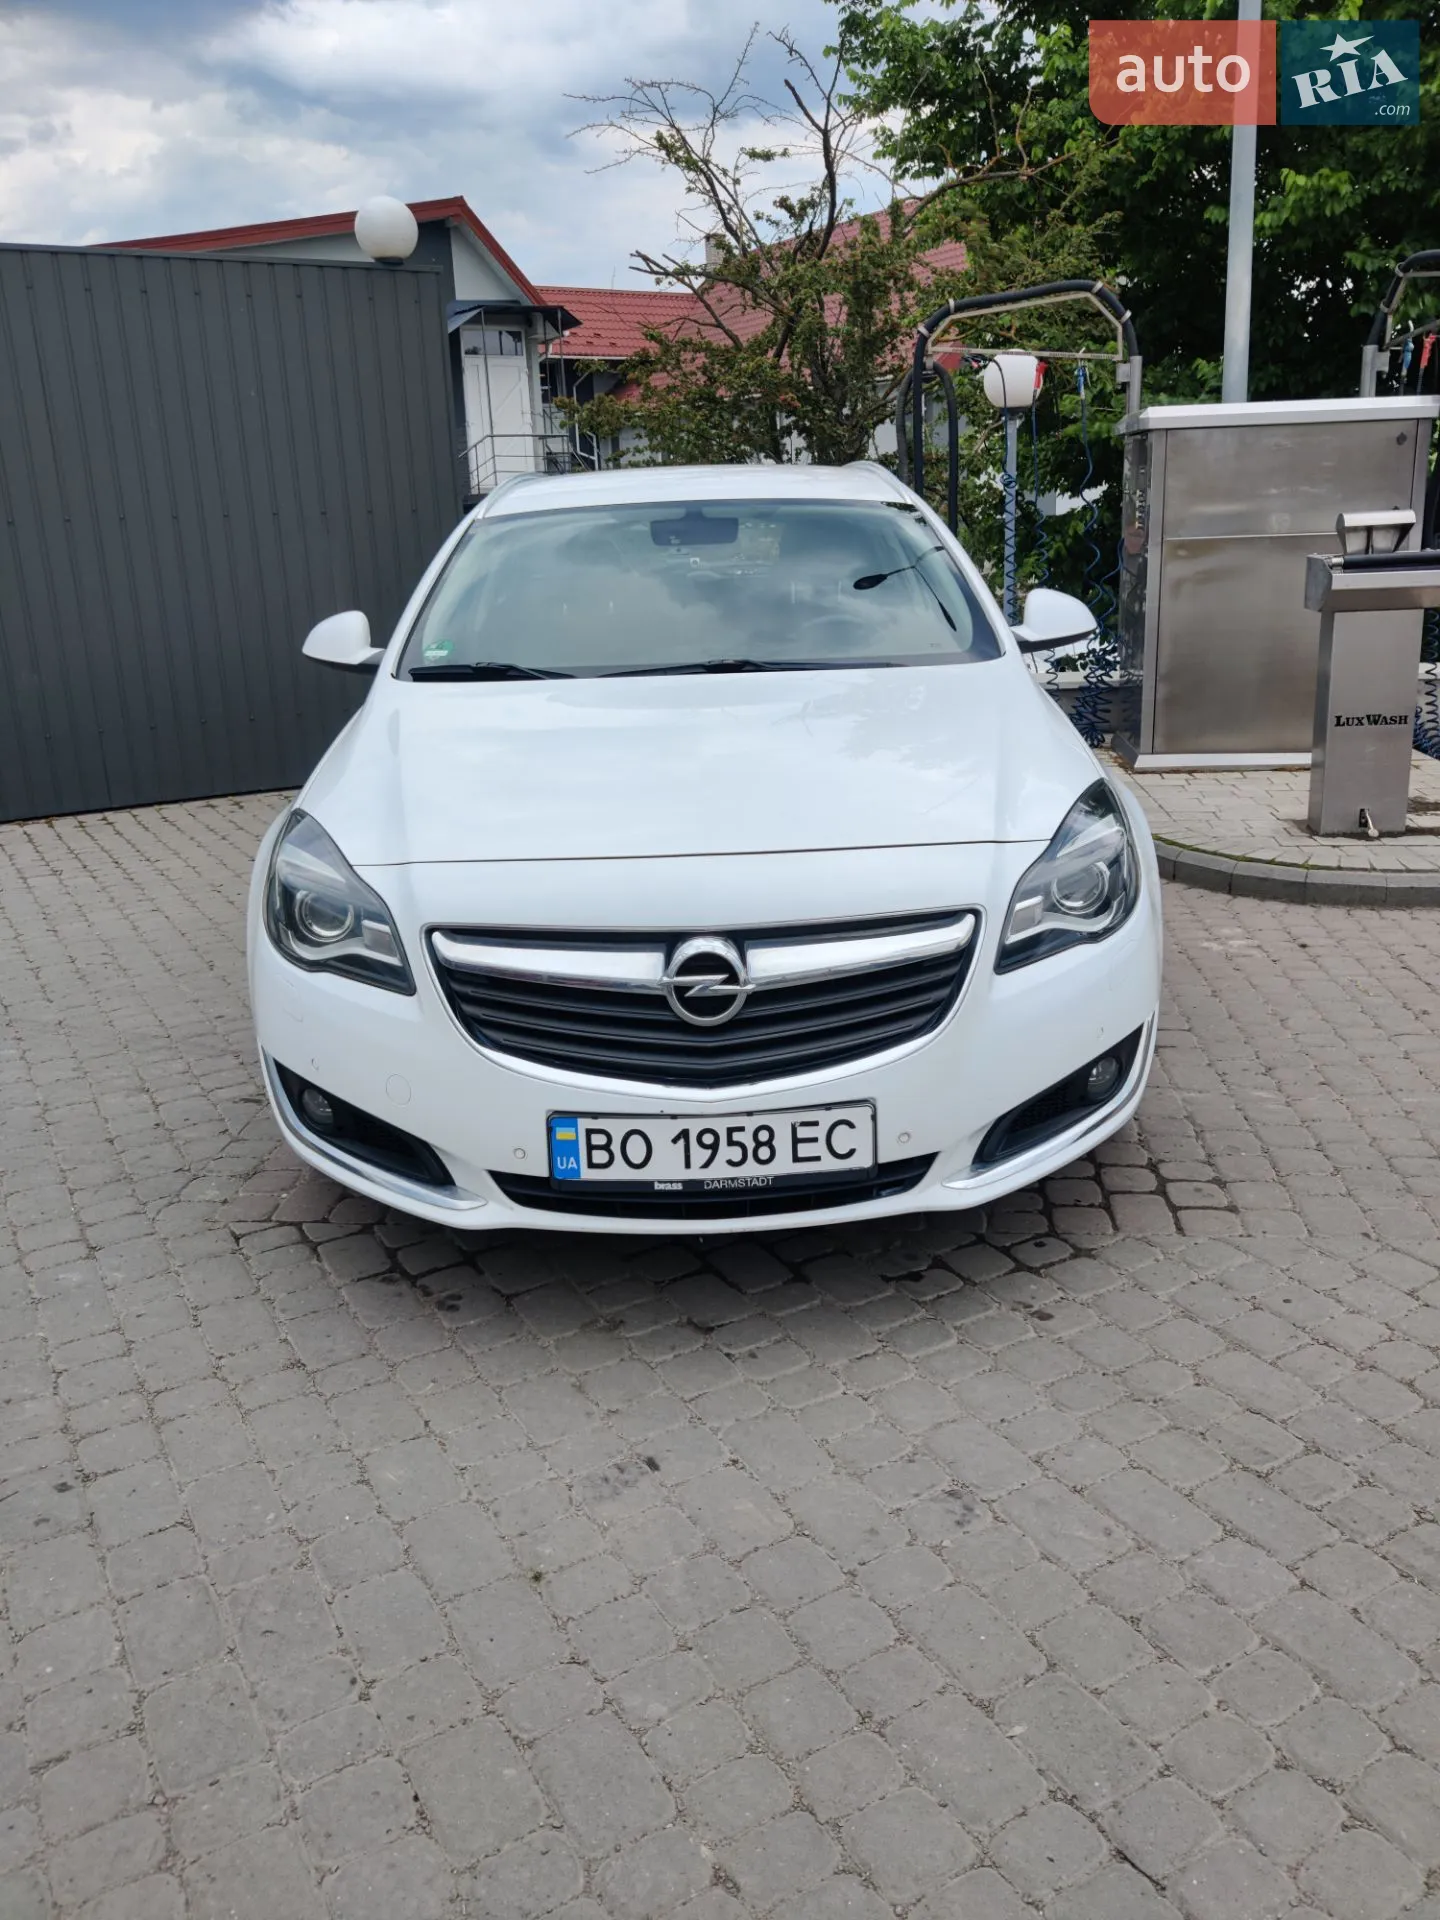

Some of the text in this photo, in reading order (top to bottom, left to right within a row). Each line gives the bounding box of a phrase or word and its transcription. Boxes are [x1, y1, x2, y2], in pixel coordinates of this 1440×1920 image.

[585, 1118, 857, 1170] BO 1958 EC
[557, 1156, 578, 1170] UA
[653, 1176, 775, 1190] brass DARMSTADT
